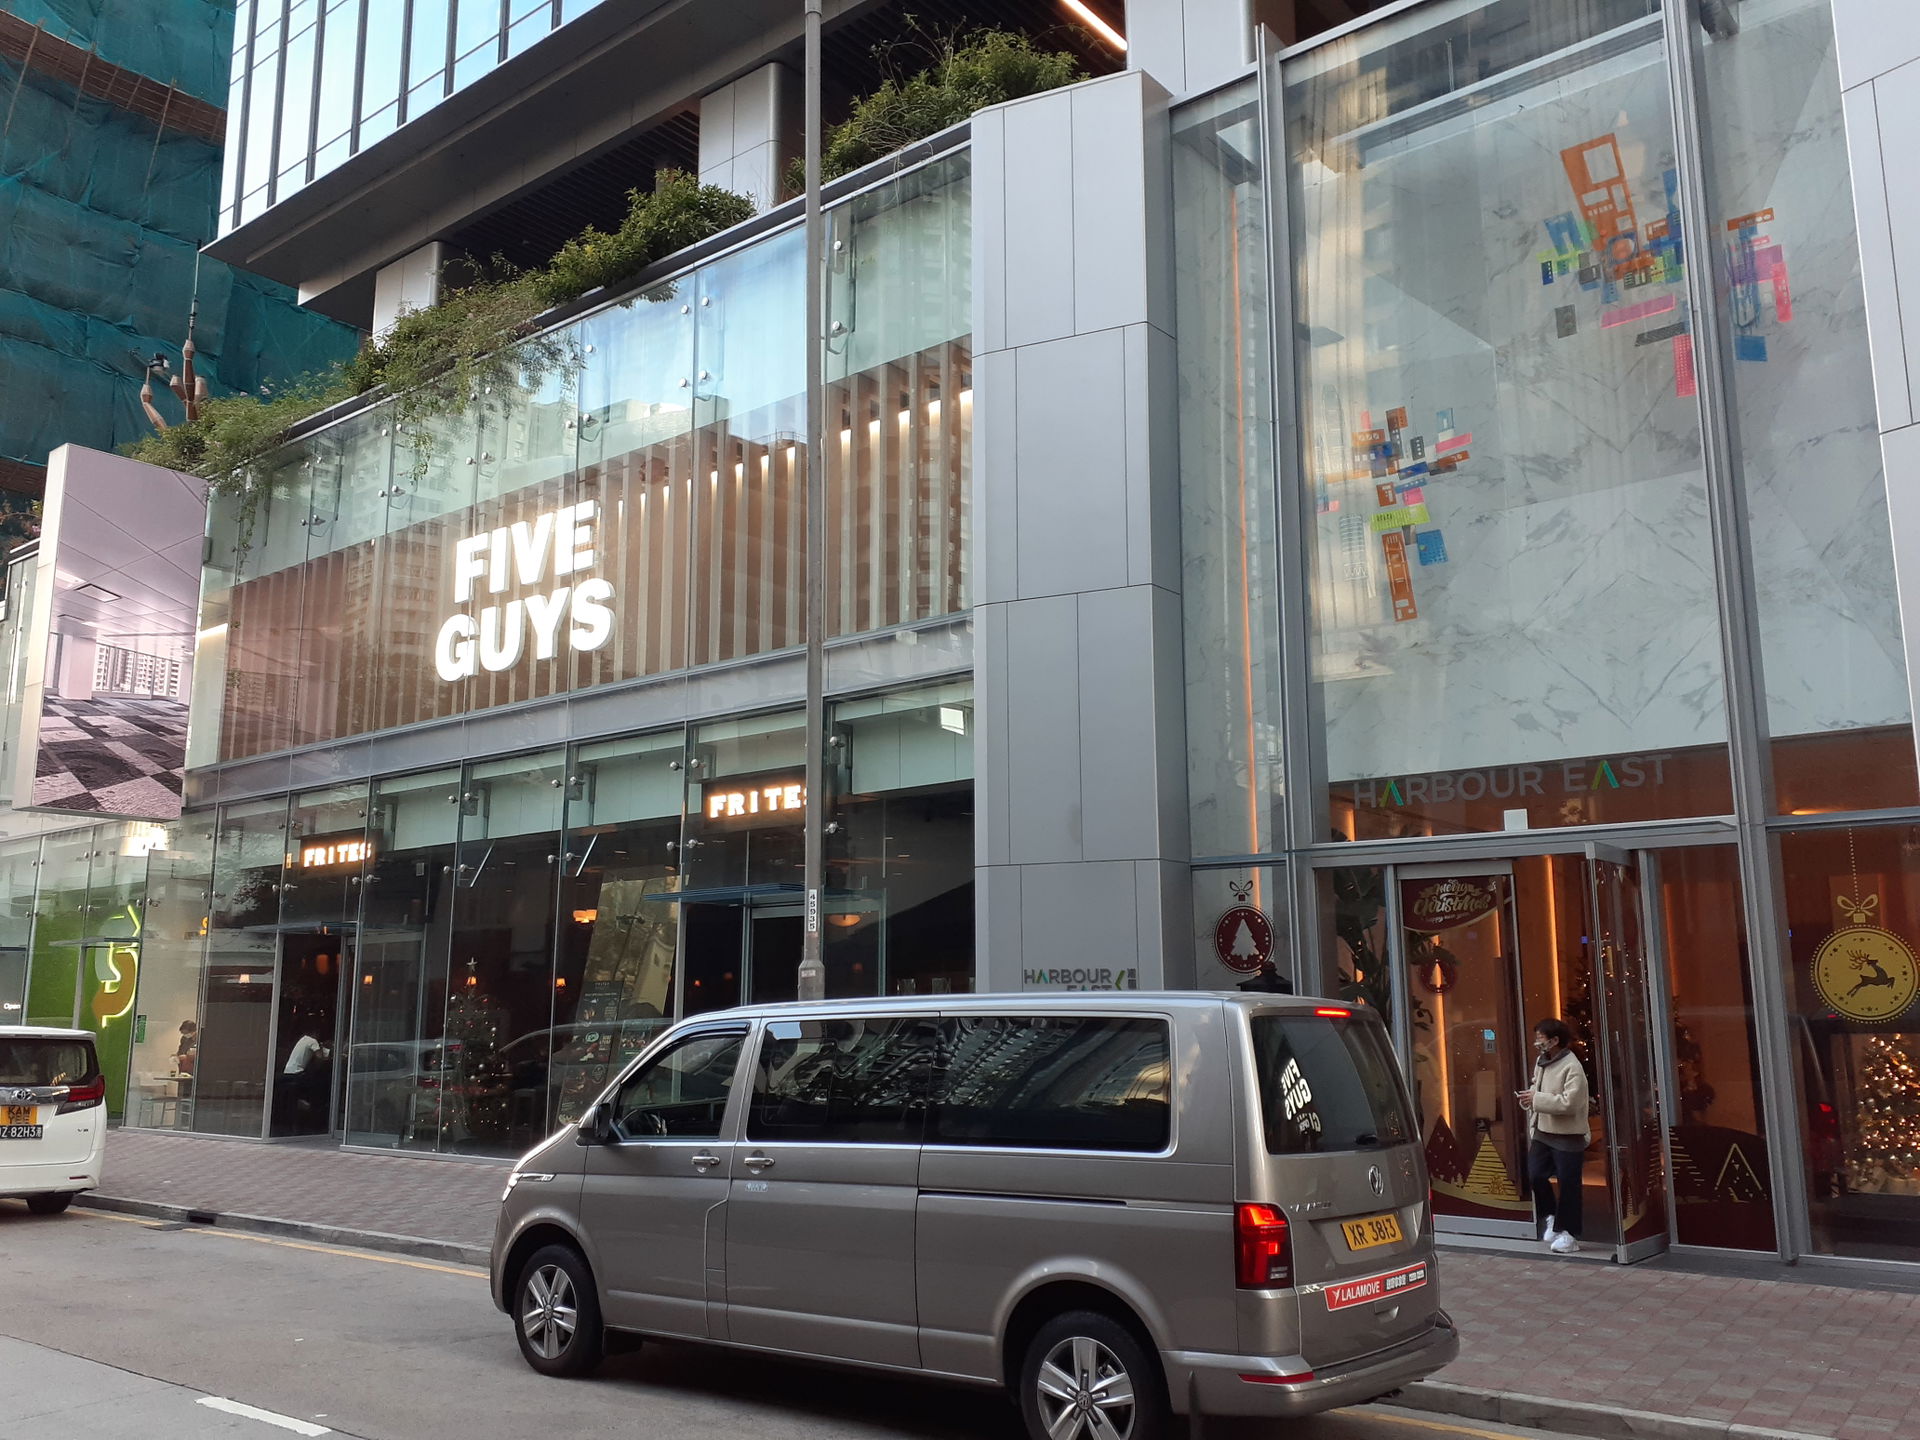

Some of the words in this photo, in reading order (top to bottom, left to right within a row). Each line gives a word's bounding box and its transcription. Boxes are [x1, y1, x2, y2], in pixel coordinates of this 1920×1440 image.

[455, 499, 599, 604] FIVE
[435, 577, 617, 682] GUYS
[1353, 763, 1545, 809] HARBOUR
[1563, 753, 1672, 792] EAST
[709, 784, 808, 819] FRITE
[303, 841, 372, 868] FRITES
[1023, 968, 1112, 984] HARBOUR
[1348, 1224, 1369, 1247] XR
[1368, 1218, 1398, 1242] 3813
[1341, 1281, 1381, 1302] LALAMOVE
